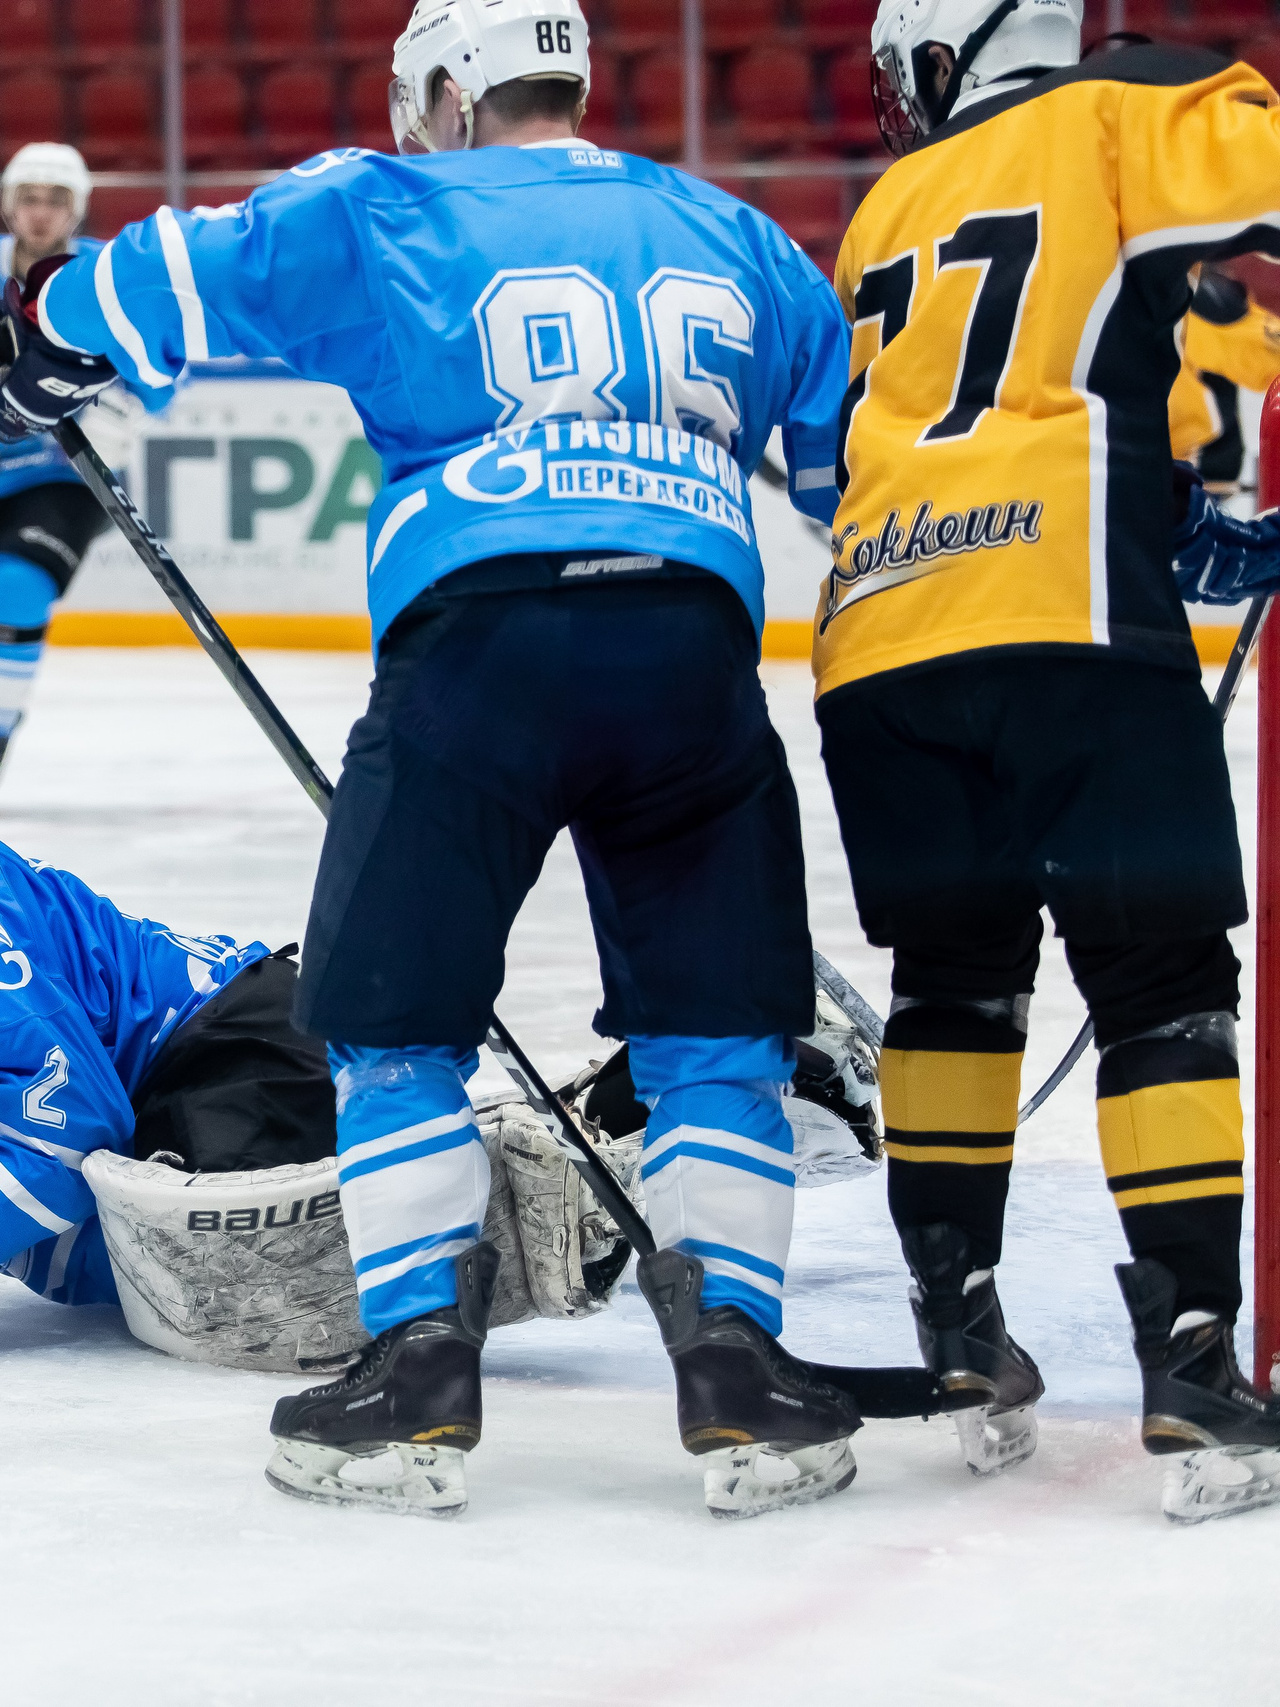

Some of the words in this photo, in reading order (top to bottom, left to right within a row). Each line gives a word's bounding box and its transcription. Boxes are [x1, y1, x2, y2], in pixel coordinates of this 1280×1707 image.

[410, 13, 450, 42] BAUER
[536, 20, 572, 54] 86
[472, 264, 756, 450] 86
[854, 202, 1043, 448] 77
[111, 485, 173, 560] CCM
[114, 437, 383, 543] ГРА
[22, 1044, 70, 1130] 2
